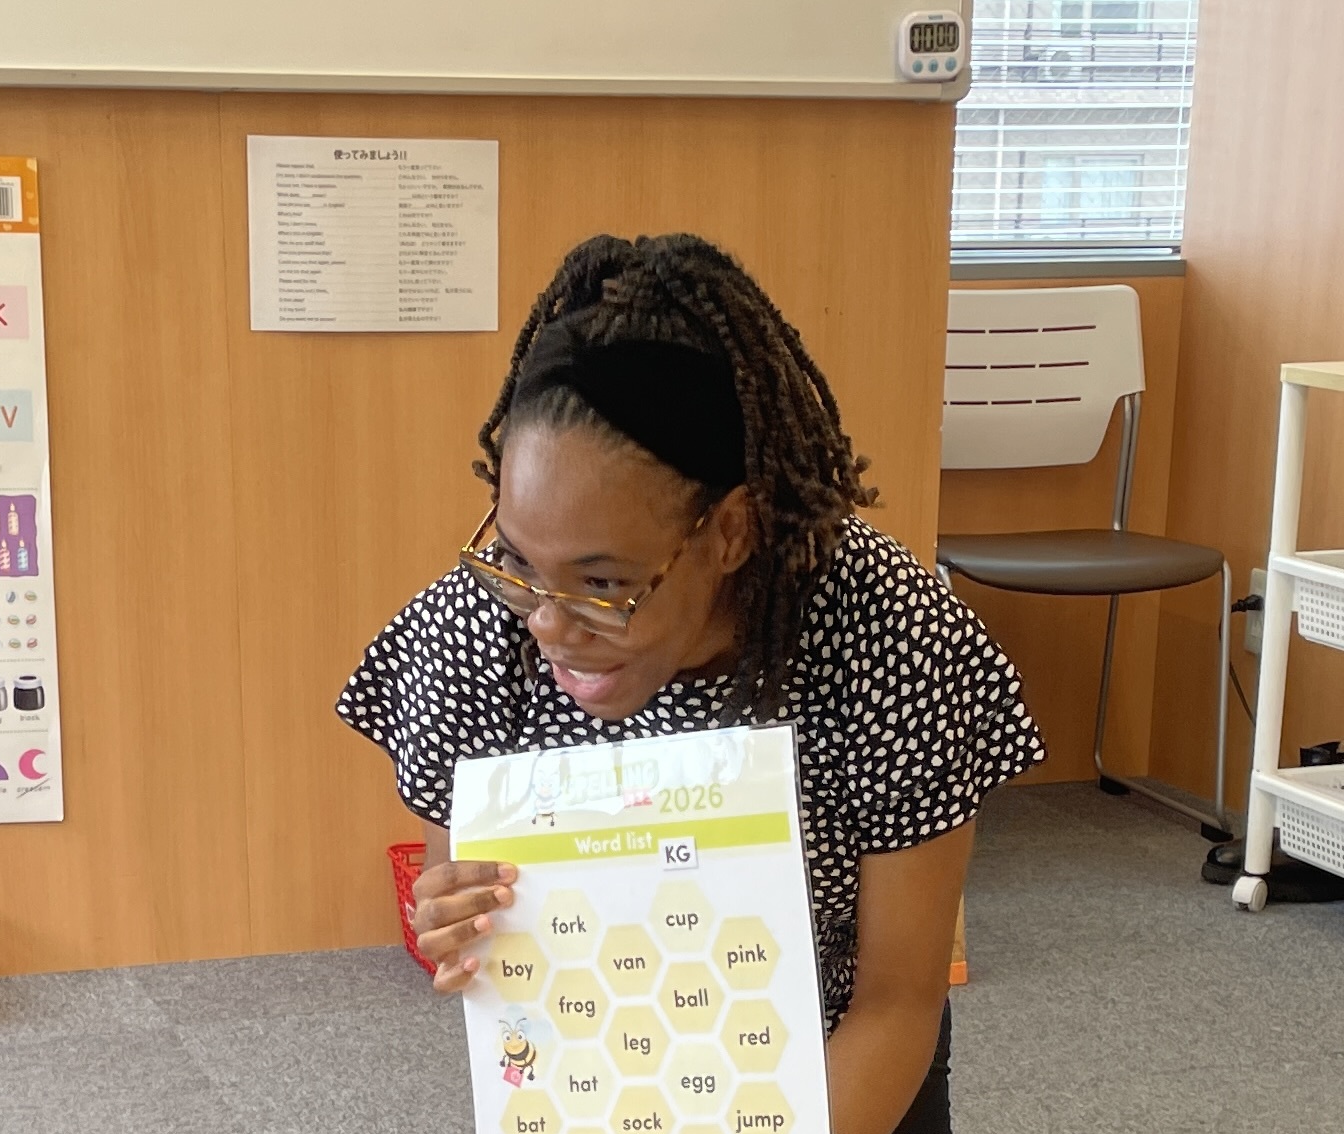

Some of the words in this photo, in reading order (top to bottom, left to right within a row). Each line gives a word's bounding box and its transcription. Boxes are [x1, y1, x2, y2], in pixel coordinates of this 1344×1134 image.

[20, 714, 40, 722] black
[659, 783, 724, 814] 2026
[574, 834, 622, 855] Word
[626, 832, 653, 851] list
[665, 844, 691, 863] KG
[552, 916, 587, 934] fork
[666, 912, 698, 930] cup
[613, 955, 646, 970] van
[727, 944, 768, 969] pink
[502, 960, 534, 981] boy
[558, 996, 596, 1018] frog
[674, 989, 709, 1008] ball
[624, 1032, 651, 1054] leg
[739, 1028, 770, 1046] red
[569, 1075, 598, 1092] hat
[680, 1073, 716, 1094] egg
[517, 1116, 546, 1134] bat
[622, 1113, 662, 1130] sock
[736, 1110, 784, 1133] jump
